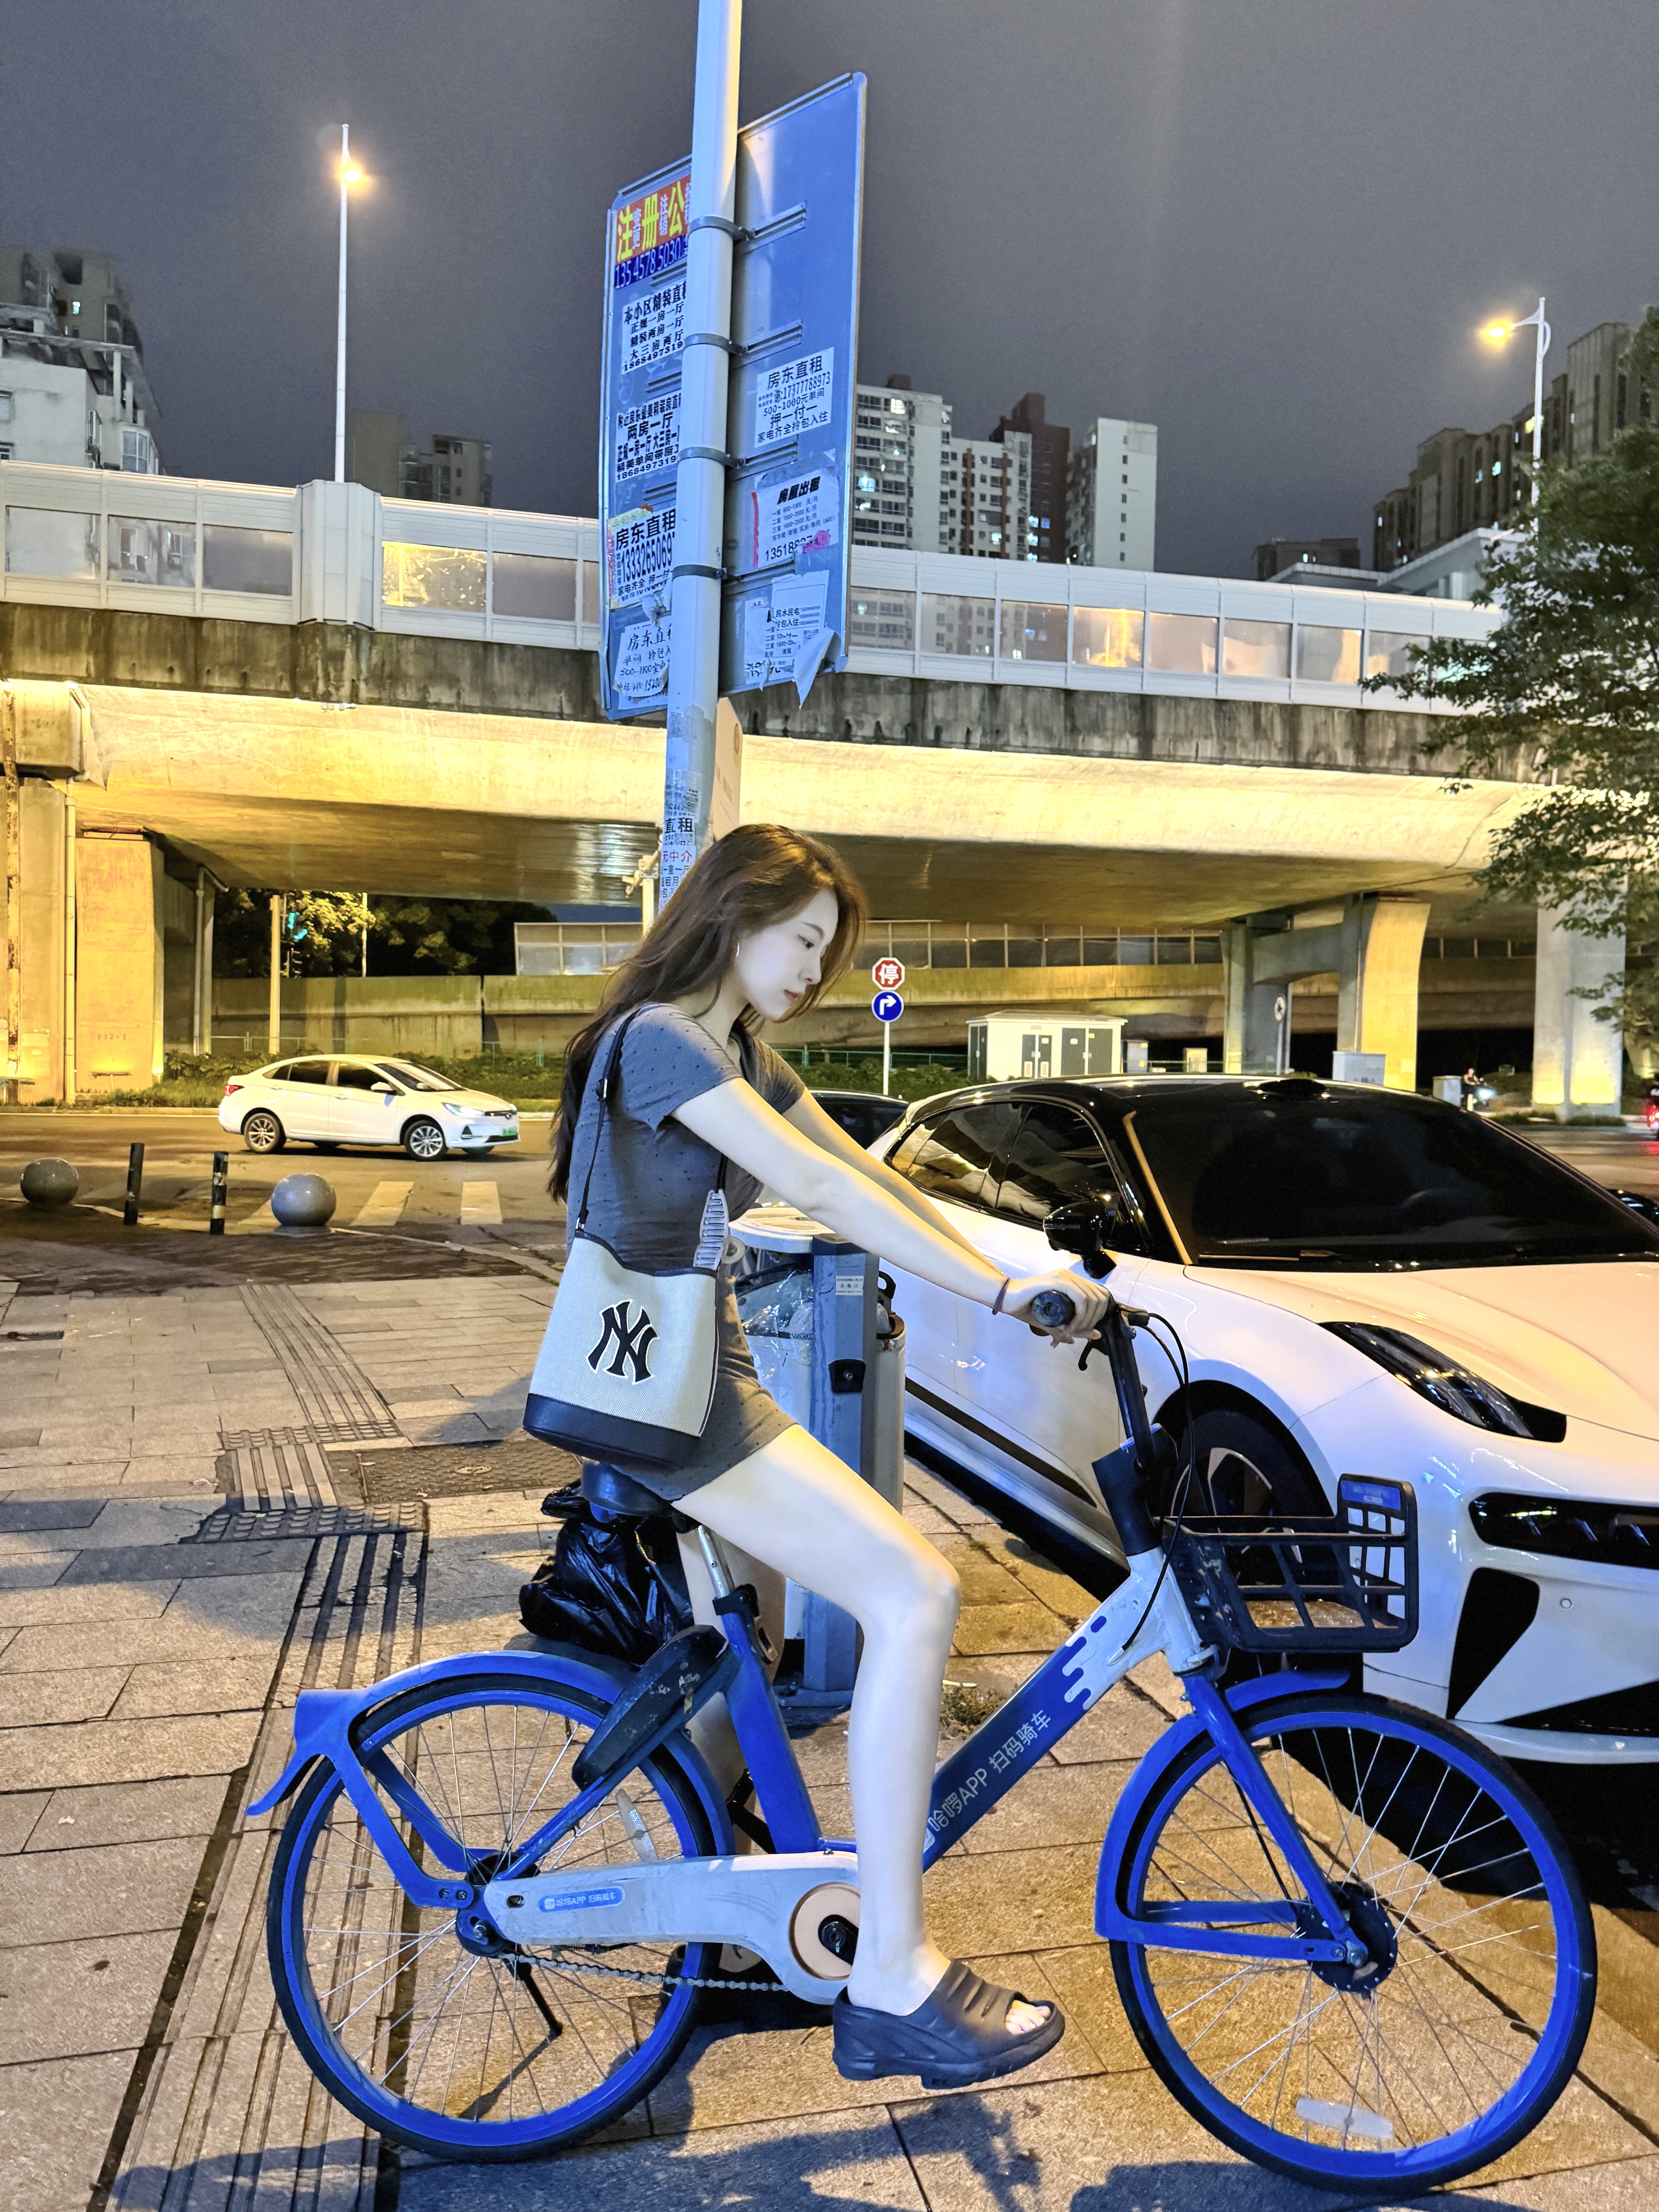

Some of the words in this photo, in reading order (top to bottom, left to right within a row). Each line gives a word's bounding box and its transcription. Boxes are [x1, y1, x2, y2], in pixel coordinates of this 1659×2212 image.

[768, 355, 823, 390] 房东直租
[628, 411, 673, 441] 两房一厅
[758, 411, 828, 443] 家电齐全拎包入住
[770, 404, 817, 429] 押一付一
[617, 455, 676, 480] 1868497319
[616, 508, 676, 551] 房东直租
[621, 531, 675, 582] 1333265069
[618, 578, 645, 596] 家电齐全
[776, 608, 800, 617] 民水民电
[665, 817, 693, 833] 直租
[879, 963, 899, 984] 停
[586, 1300, 659, 1385] NY
[927, 1767, 988, 1832] 哈啰APP
[989, 1709, 1051, 1774] 扫码骑车
